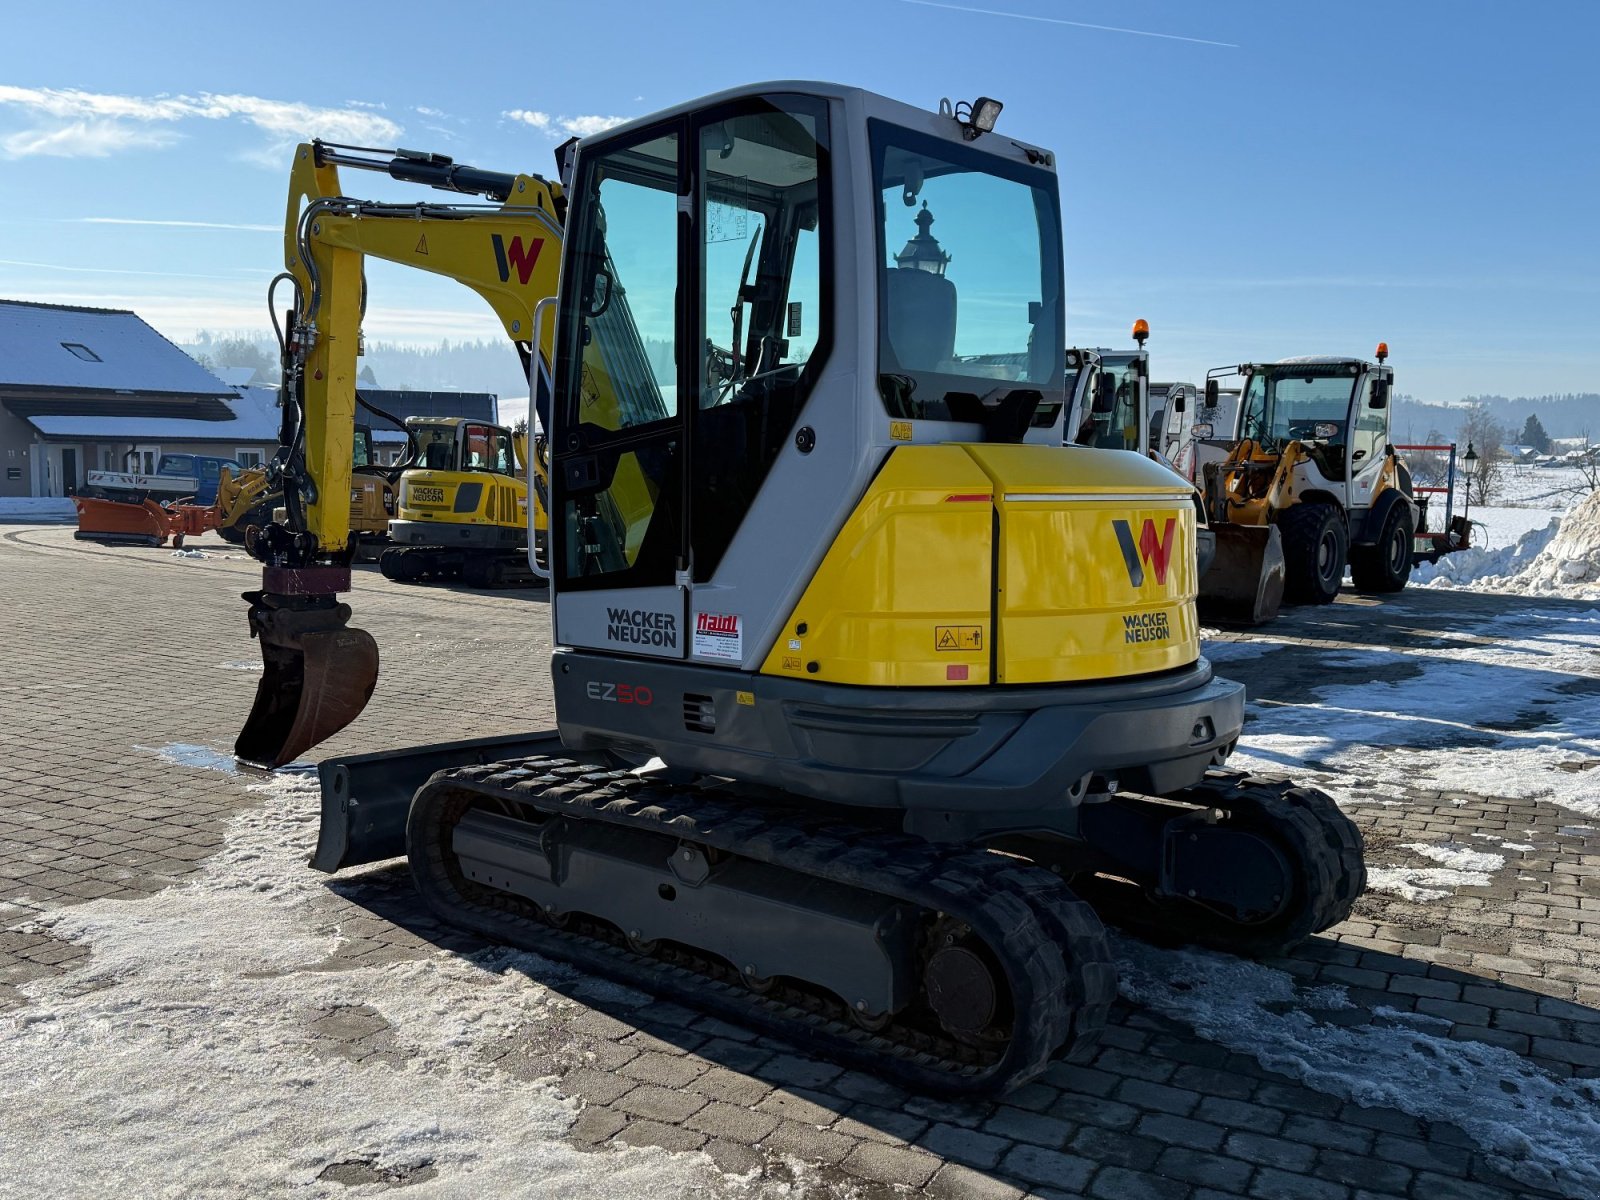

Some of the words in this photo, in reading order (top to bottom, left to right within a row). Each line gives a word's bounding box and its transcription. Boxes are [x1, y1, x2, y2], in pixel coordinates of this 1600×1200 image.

[413, 487, 443, 496] WACKER
[413, 494, 443, 502] NEUSON
[607, 608, 676, 631] WACKER
[697, 613, 738, 633] Haidl
[1123, 612, 1168, 629] WACKER
[607, 624, 677, 649] NEUSON
[1125, 627, 1170, 644] NEUSON
[587, 681, 653, 706] EZ50
